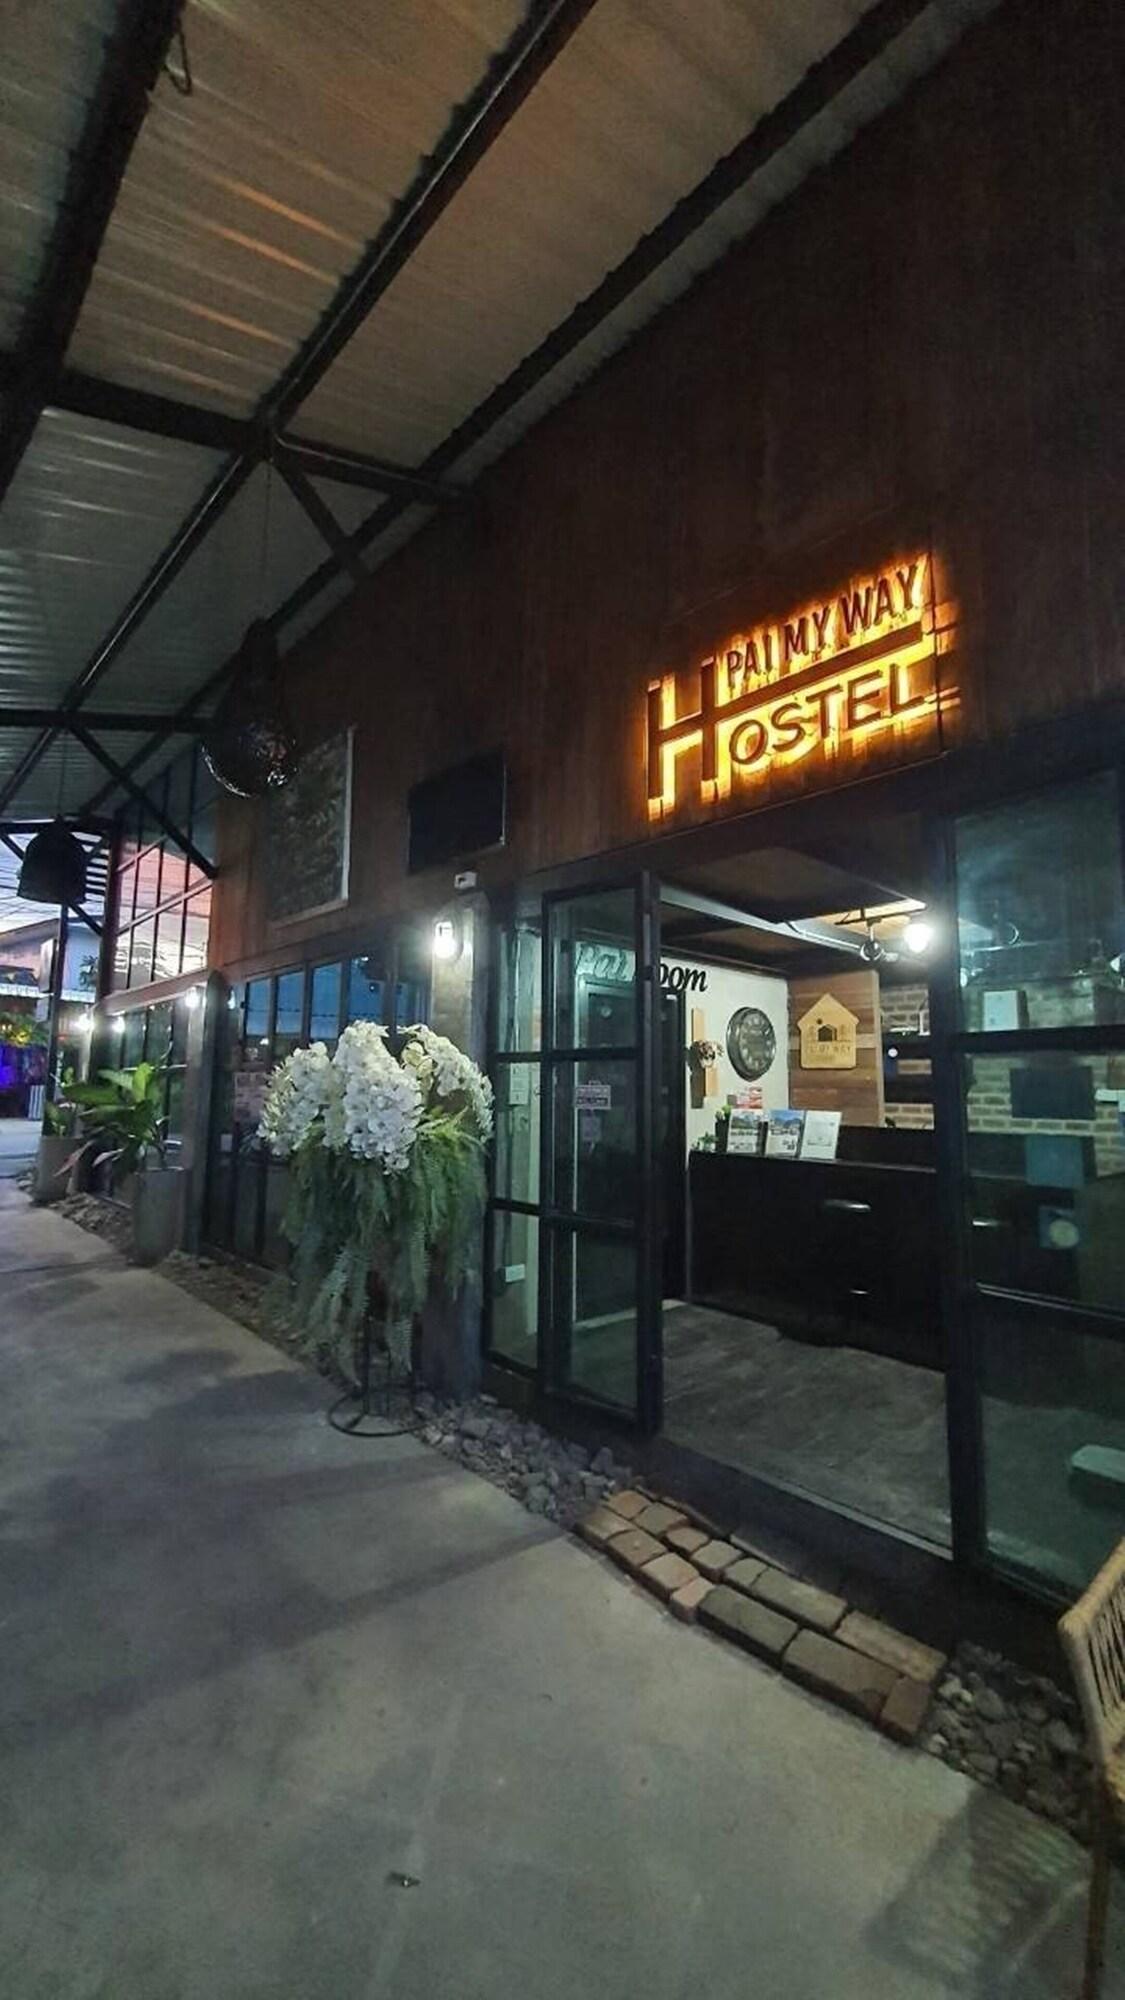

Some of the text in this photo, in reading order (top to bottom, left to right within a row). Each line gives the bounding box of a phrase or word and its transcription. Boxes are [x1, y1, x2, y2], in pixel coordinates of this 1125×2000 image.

[726, 563, 919, 690] PAI MY WAY
[647, 628, 926, 801] HOSTEL
